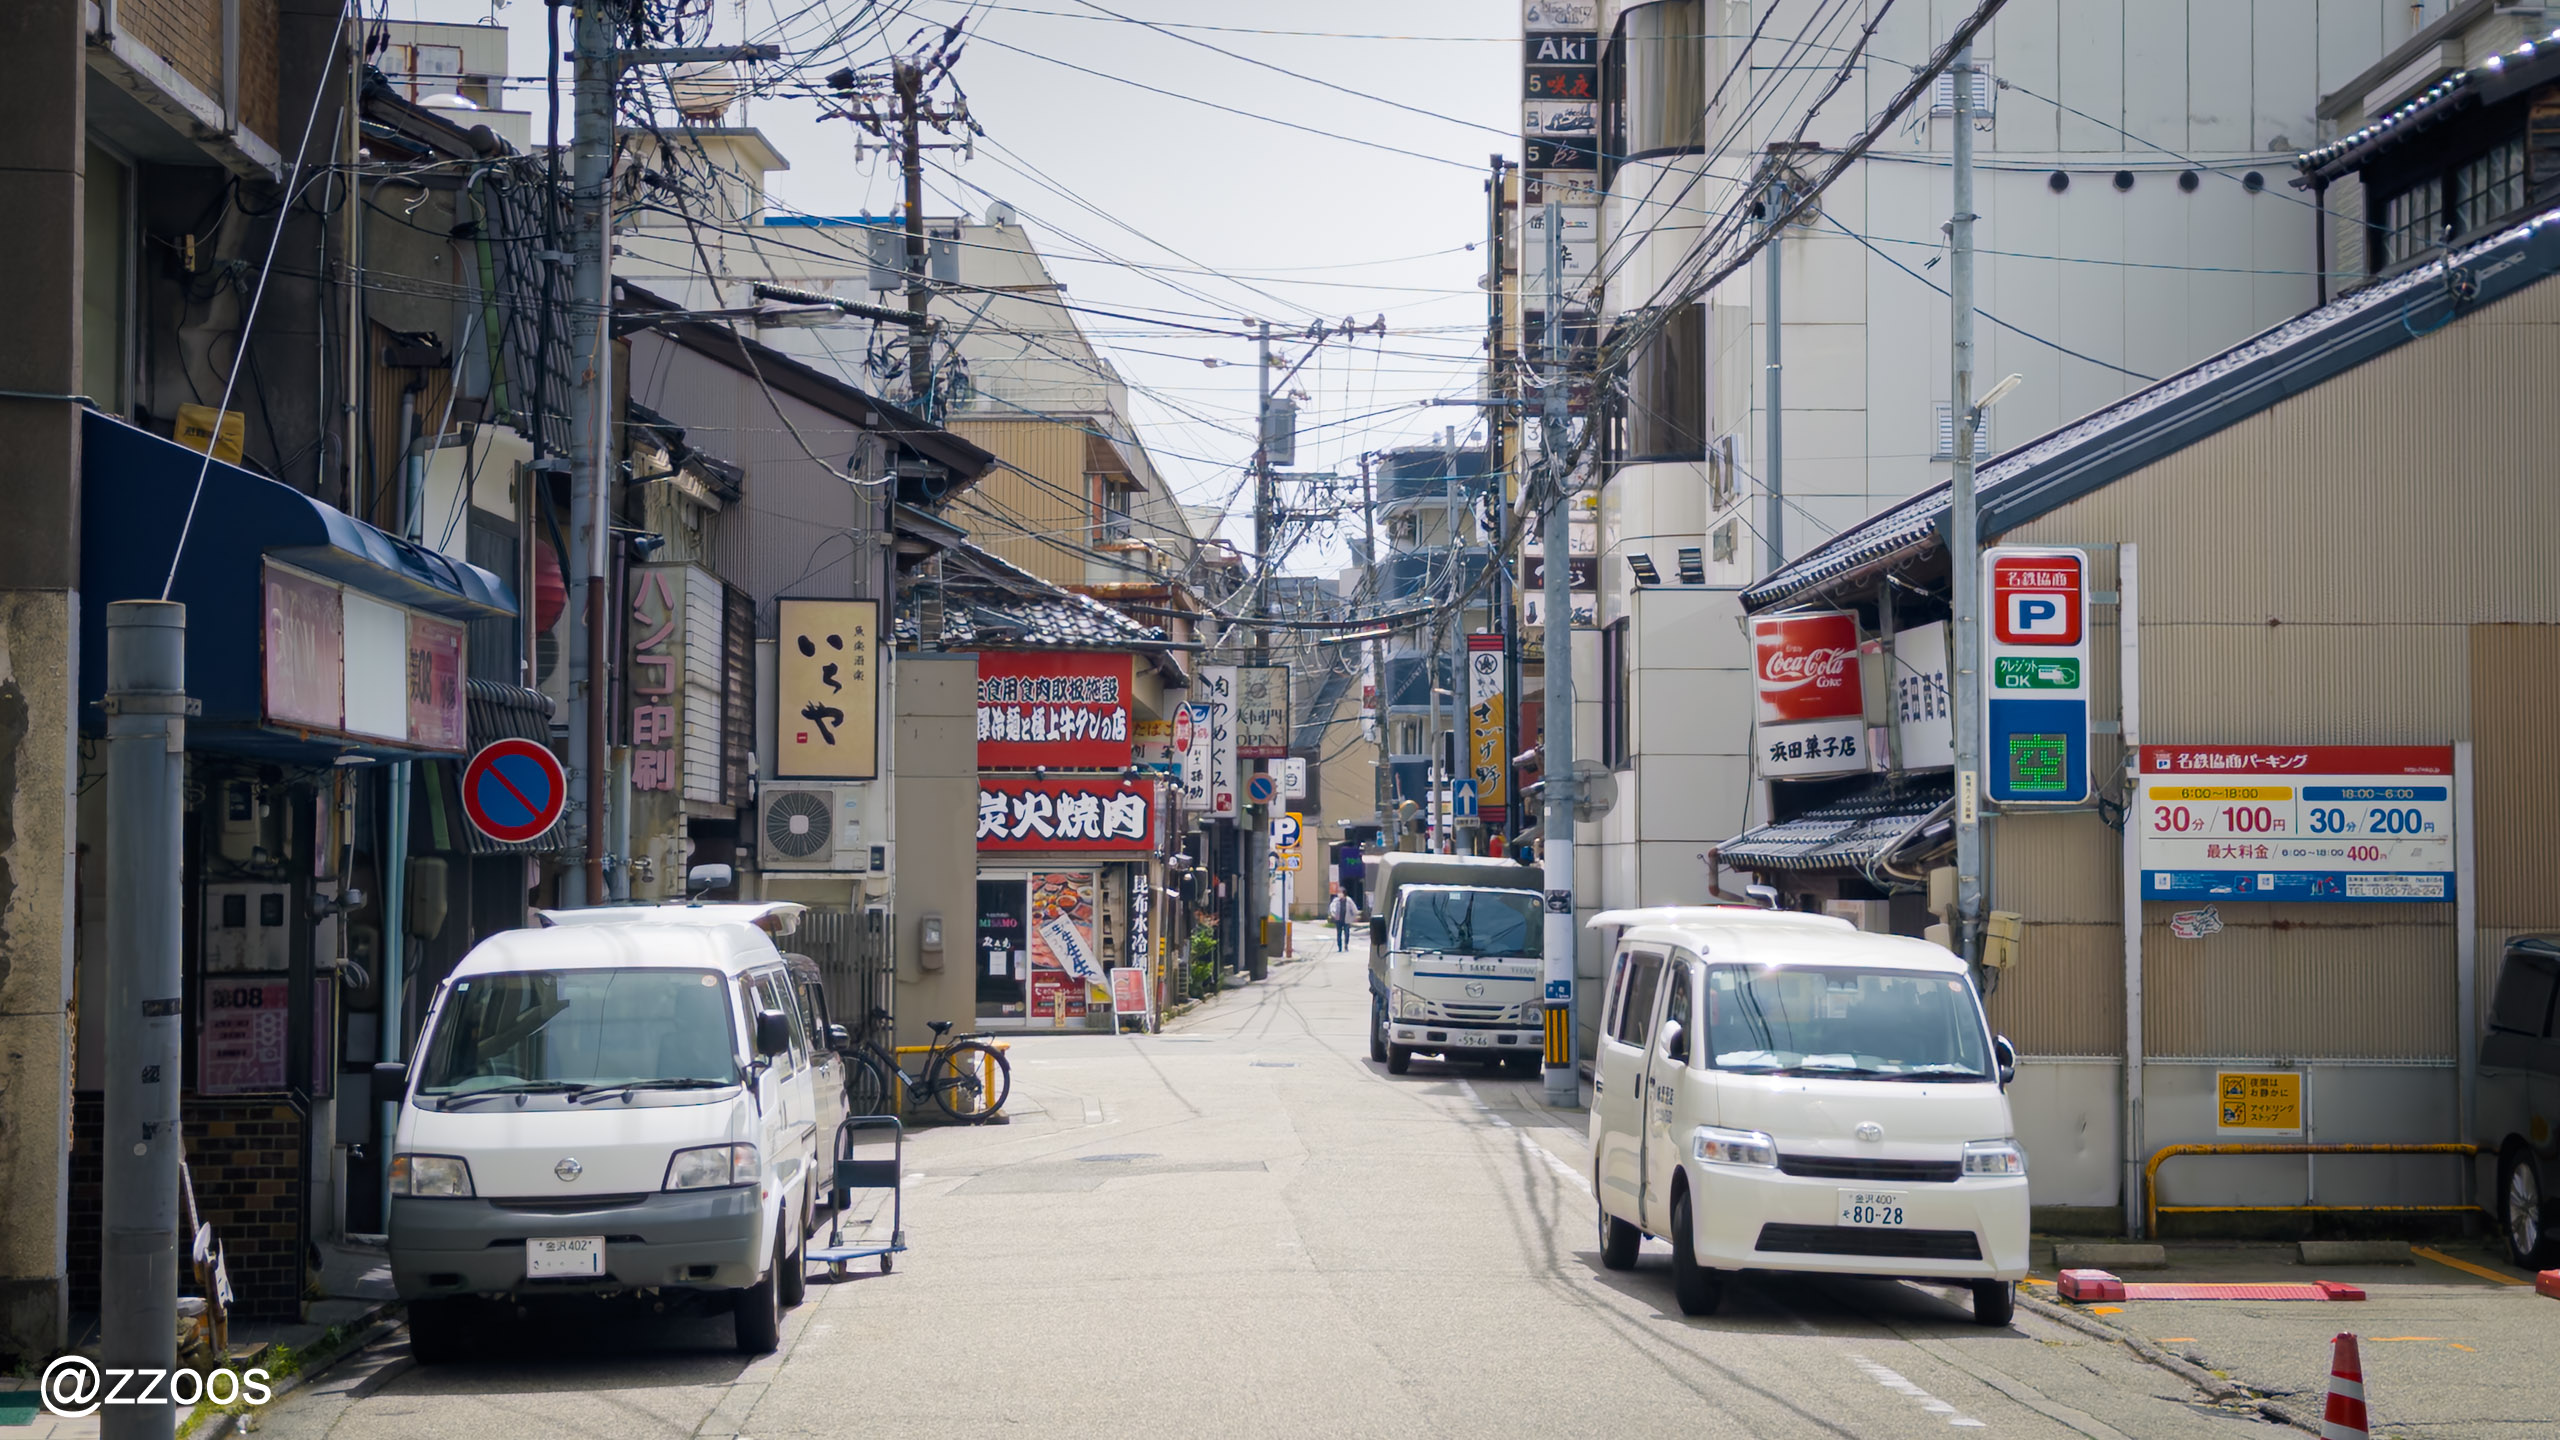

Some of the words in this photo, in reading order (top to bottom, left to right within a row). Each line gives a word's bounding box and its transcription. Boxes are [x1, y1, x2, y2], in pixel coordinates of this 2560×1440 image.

[1528, 5, 1539, 22] 6
[1537, 37, 1586, 60] Aki
[1530, 74, 1542, 92] 5
[1528, 147, 1540, 161] 5
[1527, 182, 1540, 195] 4
[2007, 571, 2068, 587] 名鉄協商
[2019, 600, 2056, 630] P
[1766, 648, 1846, 679] Coca-Cola
[2000, 659, 2038, 673] クレジット
[633, 572, 675, 791] ハンコ・印刷
[1816, 675, 1842, 688] Coke
[2005, 674, 2032, 688] OK
[1213, 676, 1230, 787] 肉のめぐみ
[1770, 735, 1857, 763] 浜田菓子店
[2009, 733, 2065, 789] 空
[2176, 752, 2308, 769] 名鉄協商パーキング
[976, 791, 1147, 839] 炭火焼肉
[2251, 1104, 2295, 1113] アイドリング
[1853, 1206, 1903, 1225] 80-28
